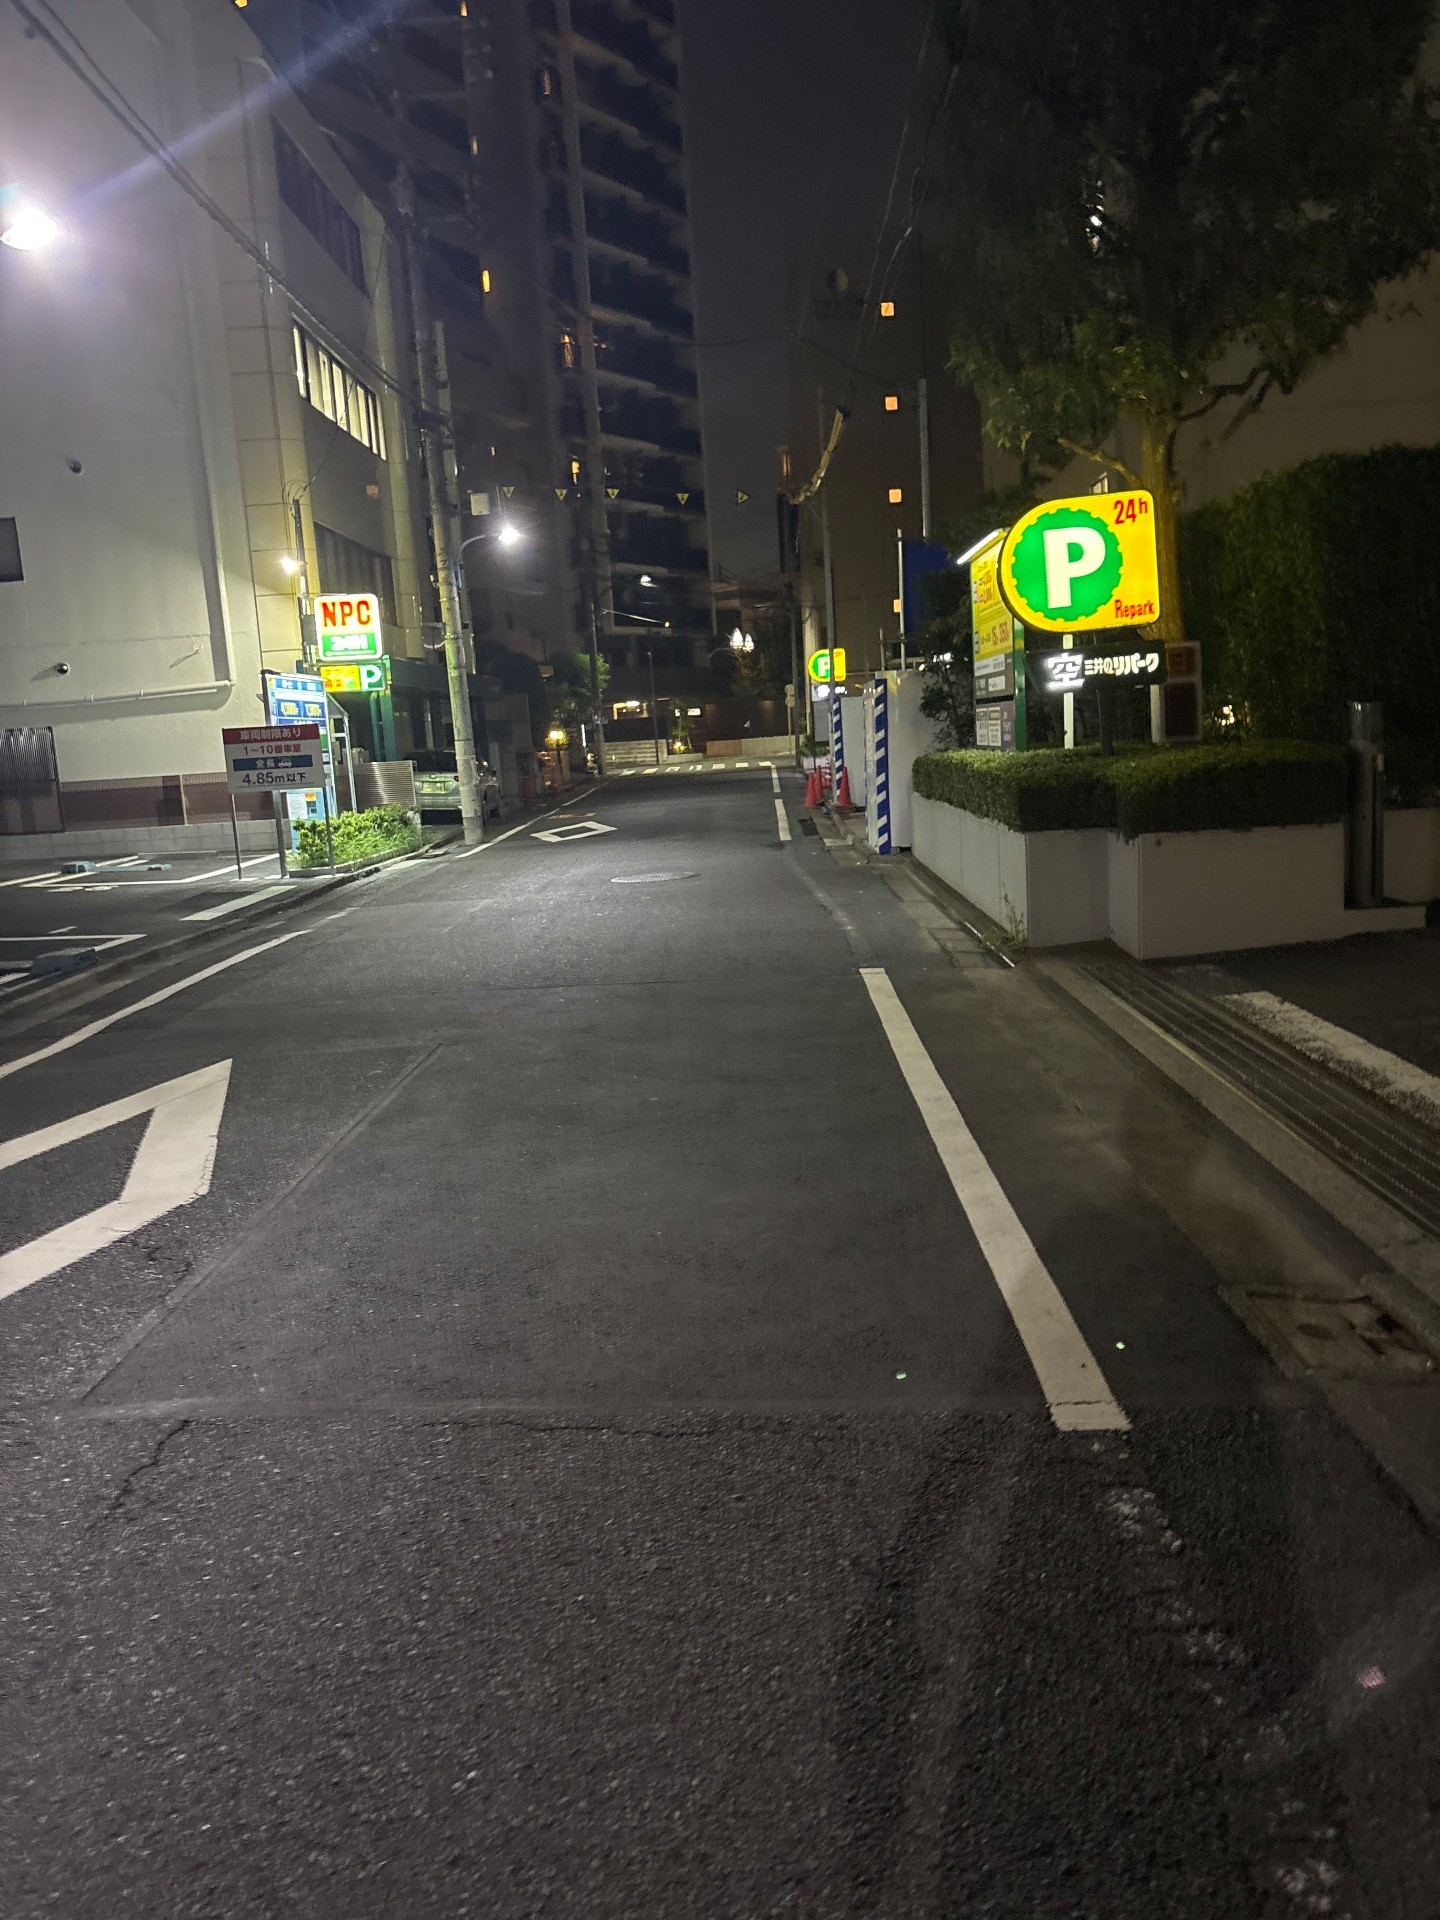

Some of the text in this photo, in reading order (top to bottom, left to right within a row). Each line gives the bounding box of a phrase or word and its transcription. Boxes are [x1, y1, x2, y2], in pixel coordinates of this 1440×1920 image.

[1114, 498, 1148, 525] 24h
[1043, 526, 1106, 609] P
[322, 600, 370, 627] NPC
[1114, 600, 1155, 619] Repark
[361, 664, 382, 689] P
[1047, 653, 1085, 689] 空
[1084, 653, 1159, 676] 三井のリパーク
[240, 727, 301, 741] 車両制限あり
[243, 772, 306, 785] 4.85m以下
